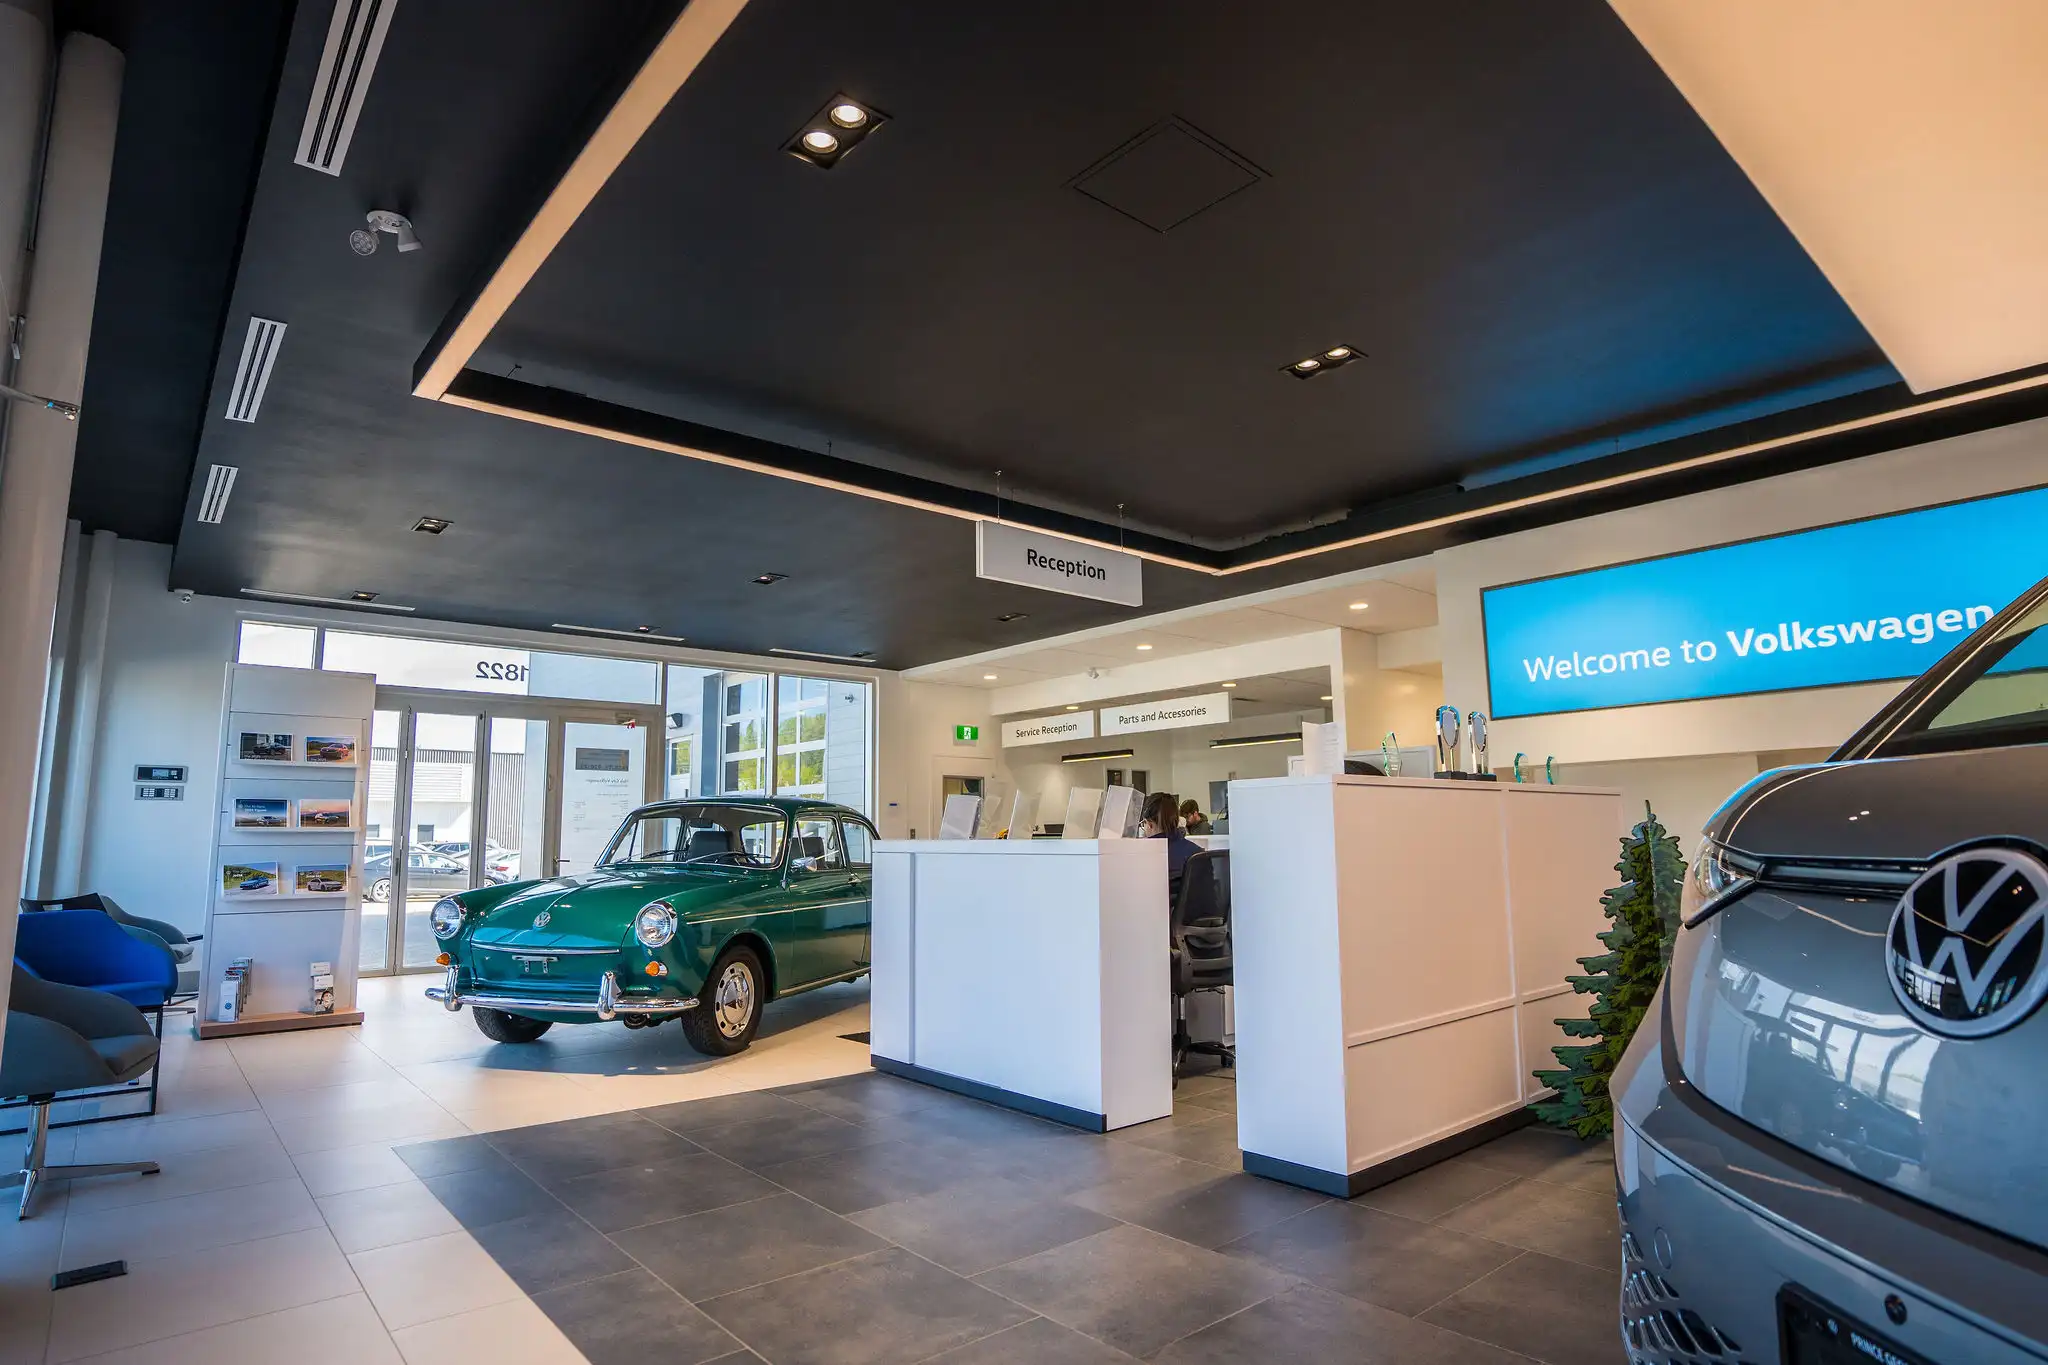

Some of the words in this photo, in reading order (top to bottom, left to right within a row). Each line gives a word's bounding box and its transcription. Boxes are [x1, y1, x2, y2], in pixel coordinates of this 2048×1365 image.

[1027, 548, 1106, 581] Reception
[1523, 646, 1671, 683] Welcome
[1679, 639, 1717, 664] to
[1726, 604, 1995, 658] Volkswagen
[1119, 714, 1139, 725] Parts
[1141, 711, 1156, 722] and
[1158, 706, 1207, 721] Accessories
[1016, 725, 1040, 738] Service
[1041, 722, 1078, 736] Reception
